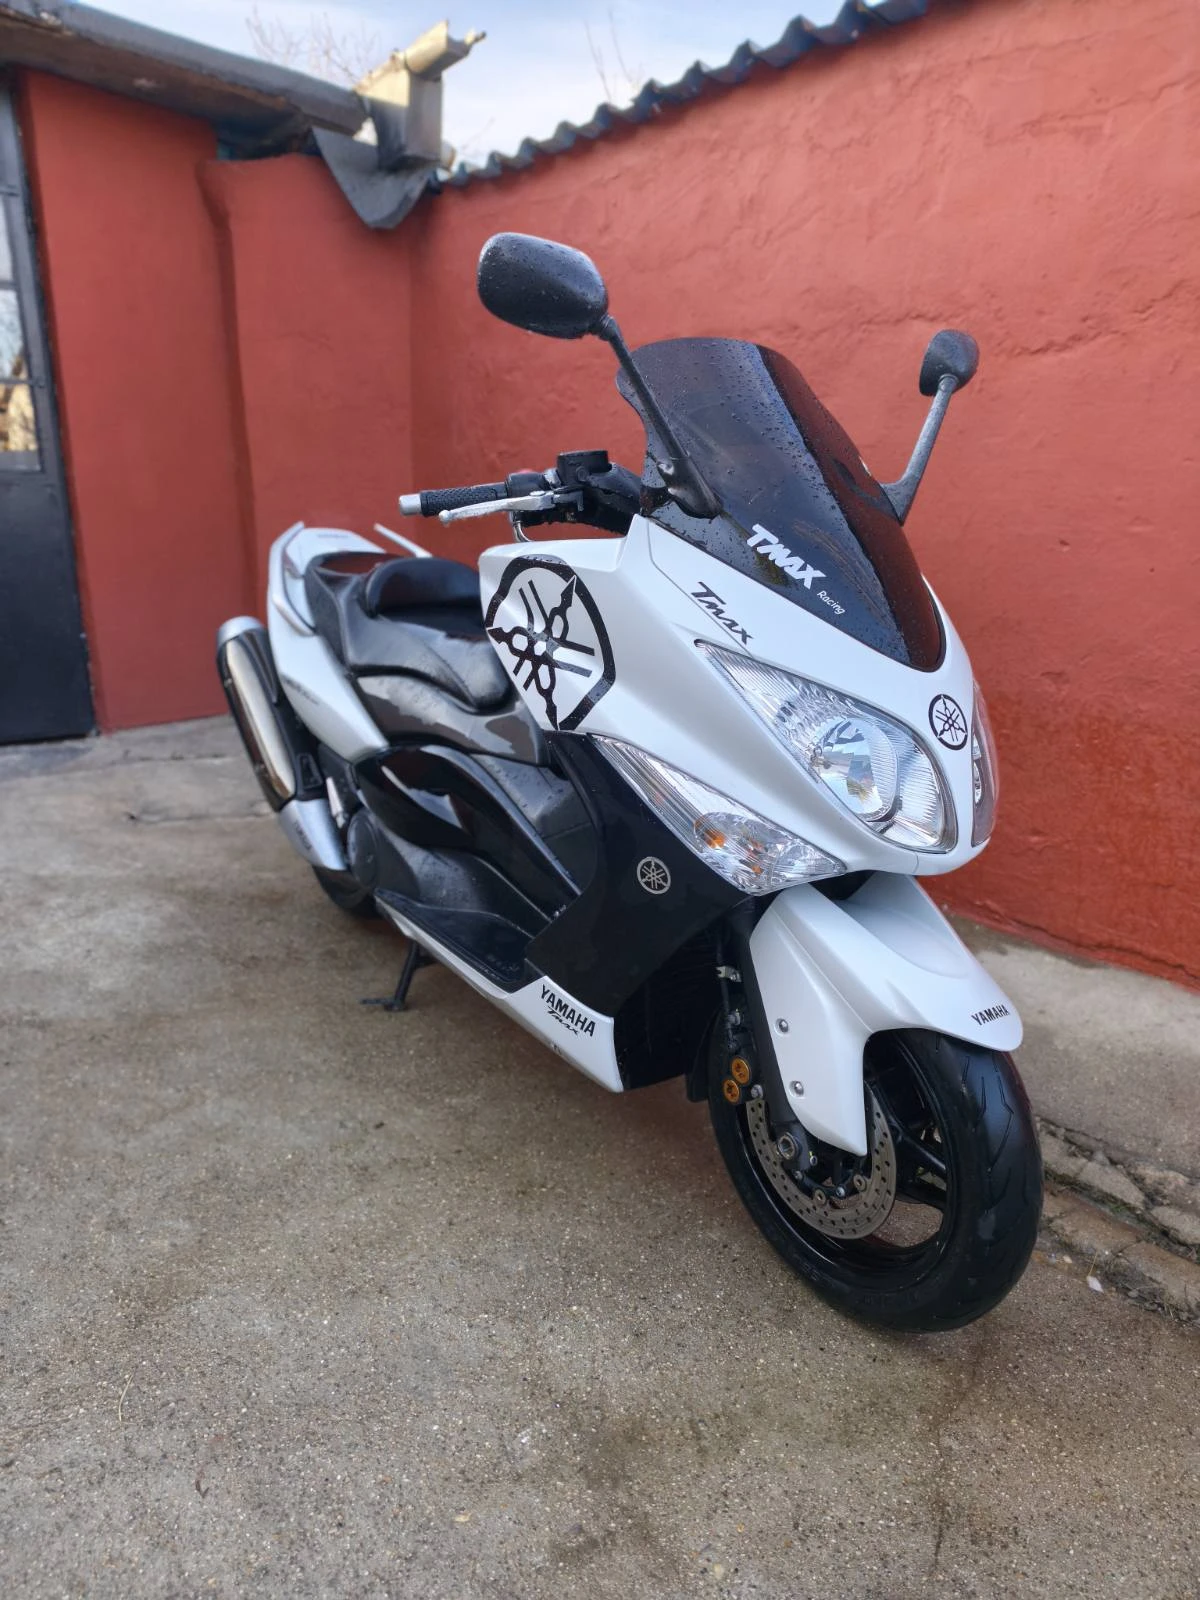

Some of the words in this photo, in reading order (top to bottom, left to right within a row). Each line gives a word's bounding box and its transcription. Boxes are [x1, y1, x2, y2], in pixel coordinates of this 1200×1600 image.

[816, 590, 846, 616] Racing
[540, 983, 596, 1037] YAMAHA
[971, 1004, 1011, 1026] YAMAHA
